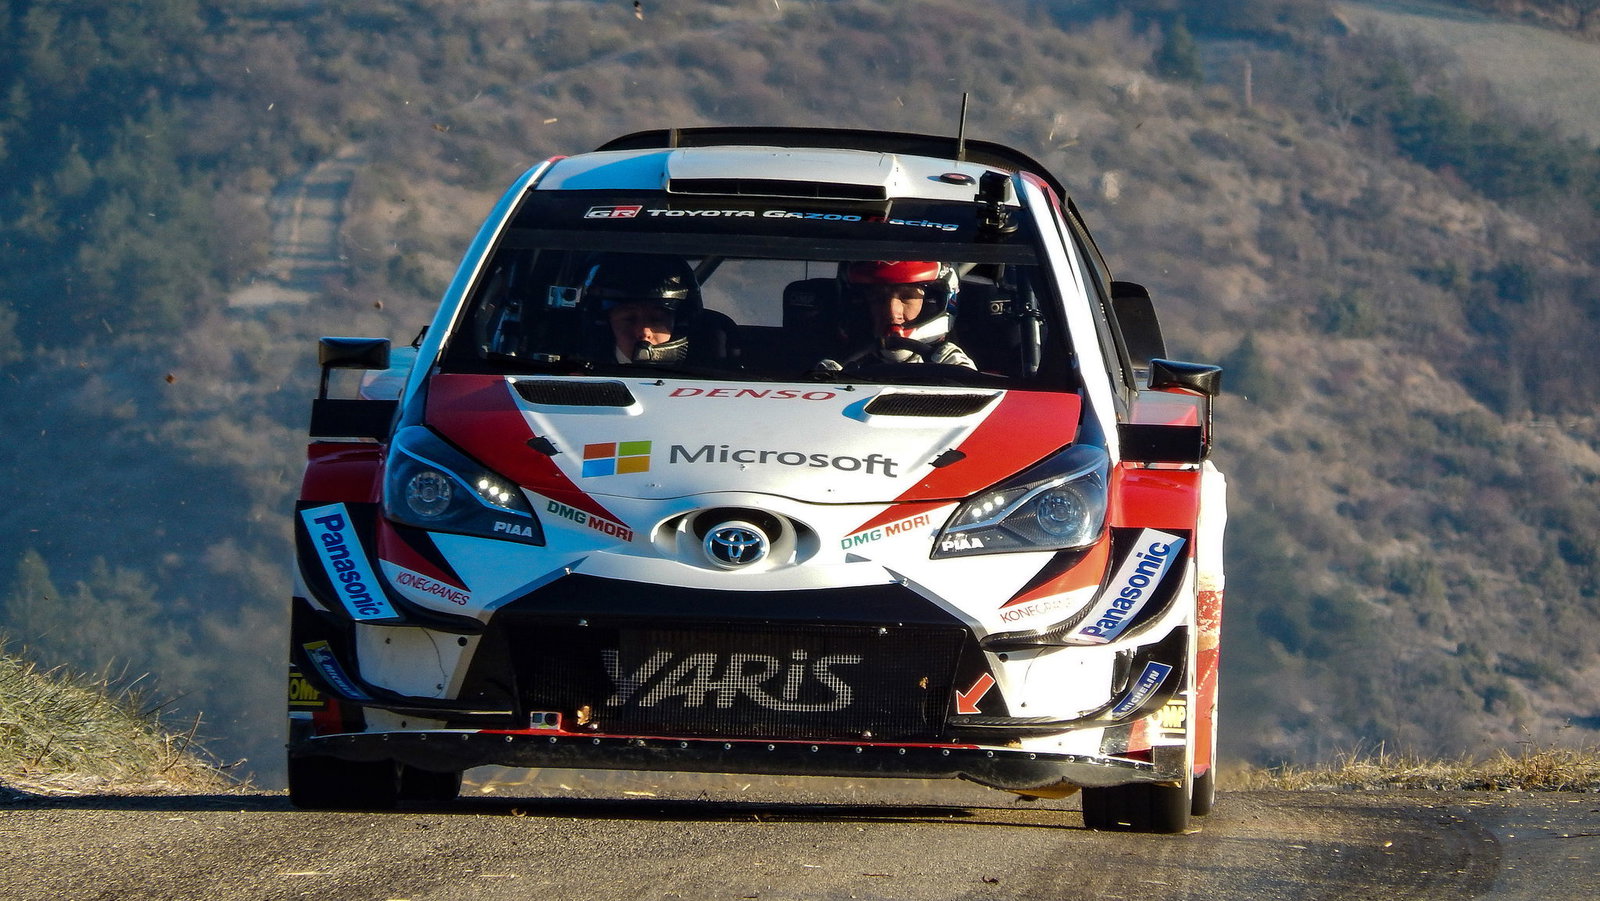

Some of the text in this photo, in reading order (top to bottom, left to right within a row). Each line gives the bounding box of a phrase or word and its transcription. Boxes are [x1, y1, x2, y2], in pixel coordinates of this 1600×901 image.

[647, 209, 755, 217] TOYOTA
[669, 387, 837, 401] DENSO
[669, 444, 898, 478] Microsoft
[494, 521, 532, 537] PIAA
[547, 500, 633, 542] DMG MORI
[841, 514, 930, 550] DMG MORI
[941, 537, 984, 551] PIAA
[314, 513, 382, 617] Panasonic
[396, 571, 471, 606] KONECRANES
[1079, 541, 1171, 638] Panasonic
[1121, 670, 1160, 711] MICHELIN
